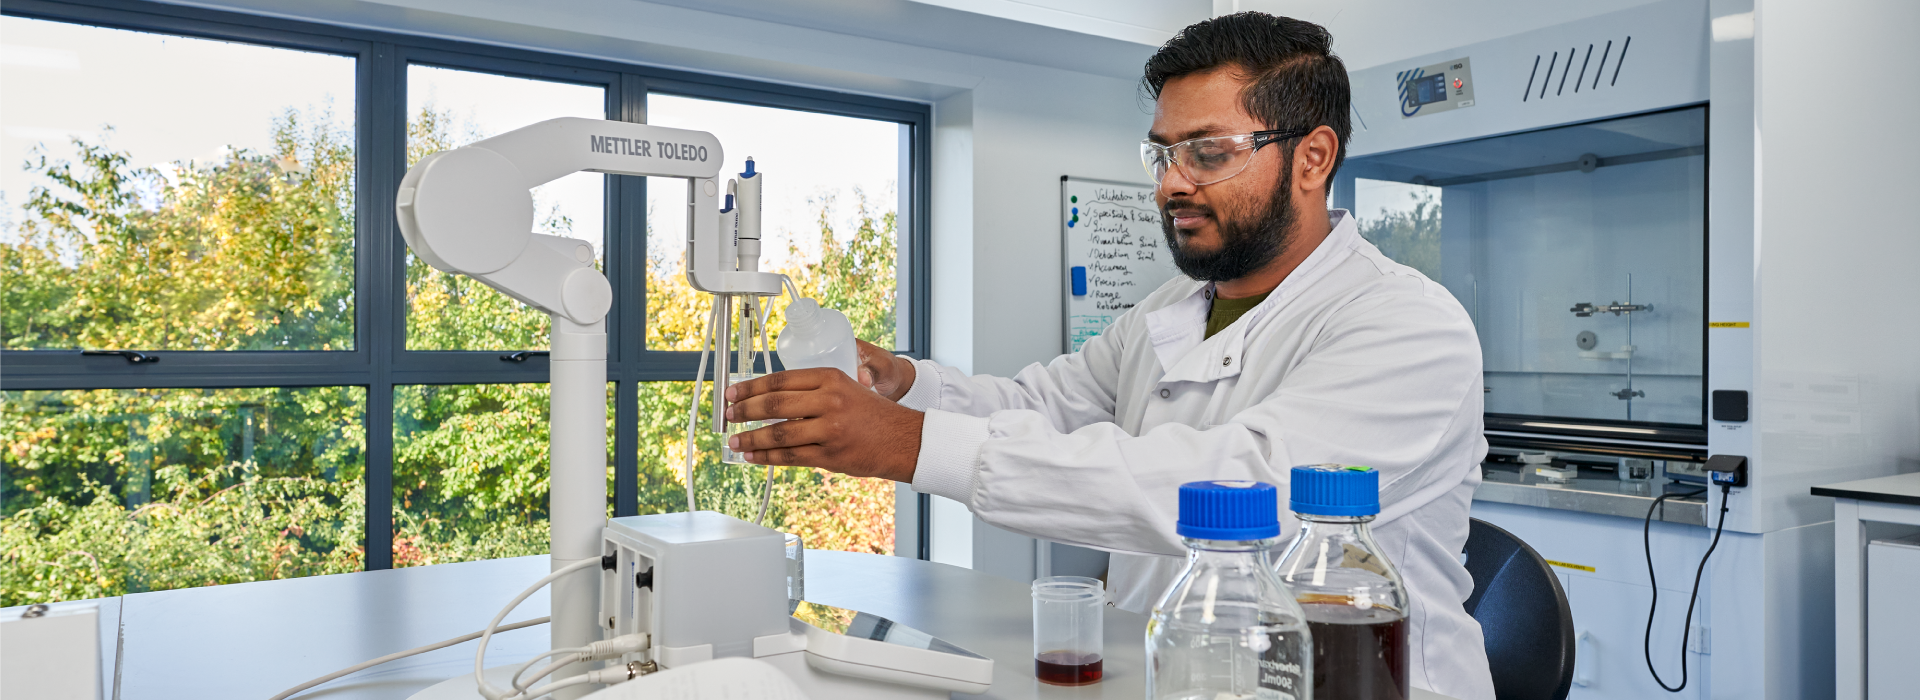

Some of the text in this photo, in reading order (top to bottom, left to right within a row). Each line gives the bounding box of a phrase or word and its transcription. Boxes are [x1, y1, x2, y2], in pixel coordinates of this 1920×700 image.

[590, 135, 708, 162] METTLER TOLEDO
[1094, 188, 1133, 202] Validation
[1094, 248, 1130, 260] Detection
[1094, 260, 1133, 276] Accuracy
[1095, 289, 1122, 304] Range
[1567, 563, 1586, 571] SOLVENTS
